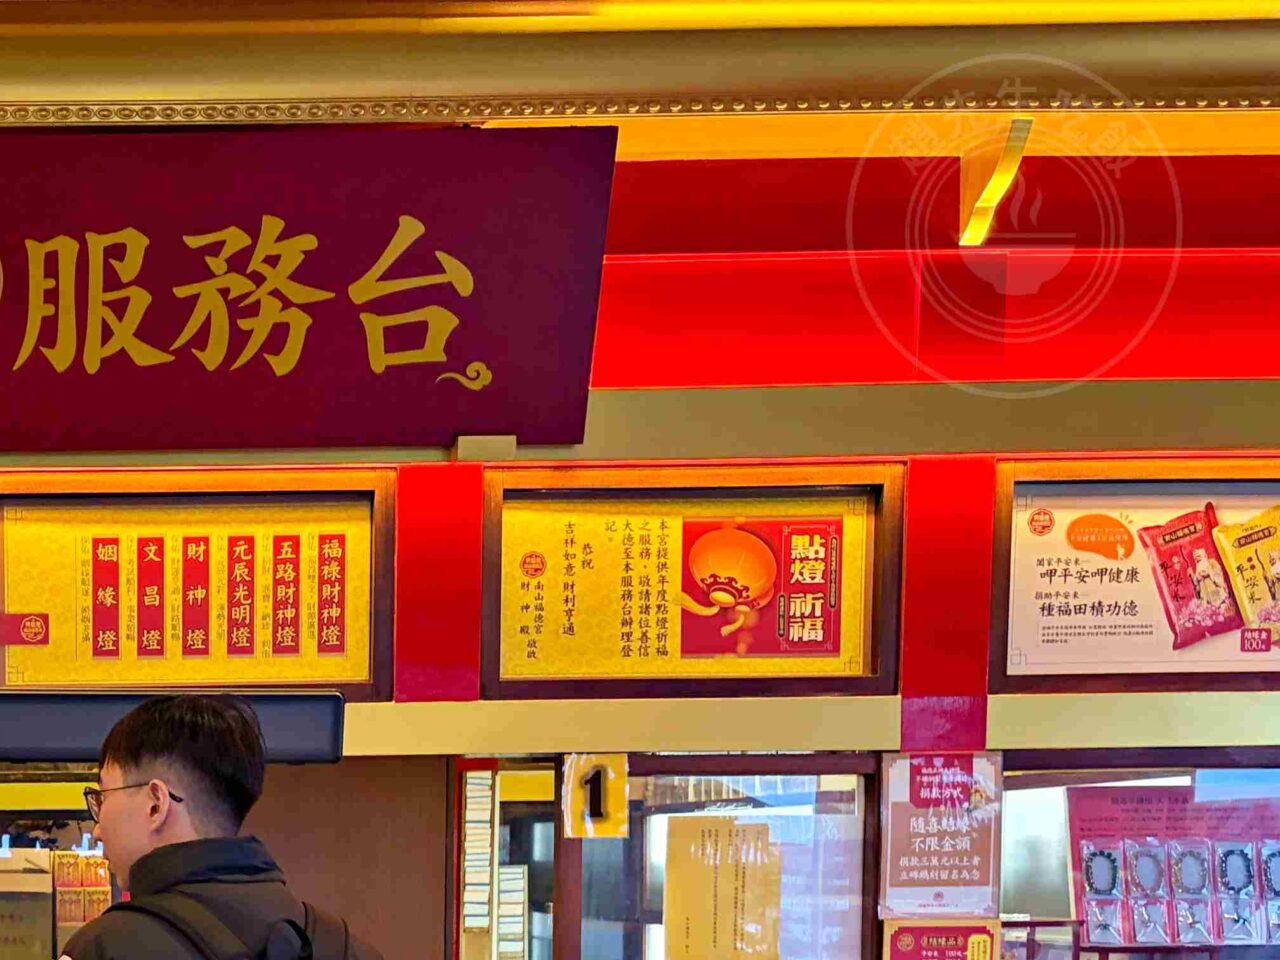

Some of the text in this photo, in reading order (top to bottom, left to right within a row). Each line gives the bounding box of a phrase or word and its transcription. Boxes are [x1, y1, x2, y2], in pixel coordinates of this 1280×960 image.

[13, 215, 475, 375] 服務台
[95, 542, 118, 651] 姻緣燈
[141, 541, 162, 650] 文昌燈
[185, 540, 207, 650] 財神燈
[231, 540, 253, 647] 元辰光明燈
[275, 540, 297, 647] 五路財神燈
[320, 538, 342, 646] 福祿財神燈
[519, 581, 531, 636] 財神殿
[534, 581, 545, 636] 南山福德宮
[562, 520, 577, 636] 吉祥如意 財利亨通
[581, 542, 595, 571] 恭祝
[620, 519, 635, 658] 大德至本服務台辦理登
[655, 518, 670, 657] 本宮提供年度點燈祈福
[789, 534, 826, 642] 點燈 祈福
[1039, 599, 1139, 617] 種福田積功德
[1040, 566, 1141, 585] 呷平安呷健康
[583, 768, 606, 819] 1
[910, 816, 971, 834] 隨喜結緣
[911, 836, 971, 852] 不限金額
[920, 787, 964, 800] 捐款方式
